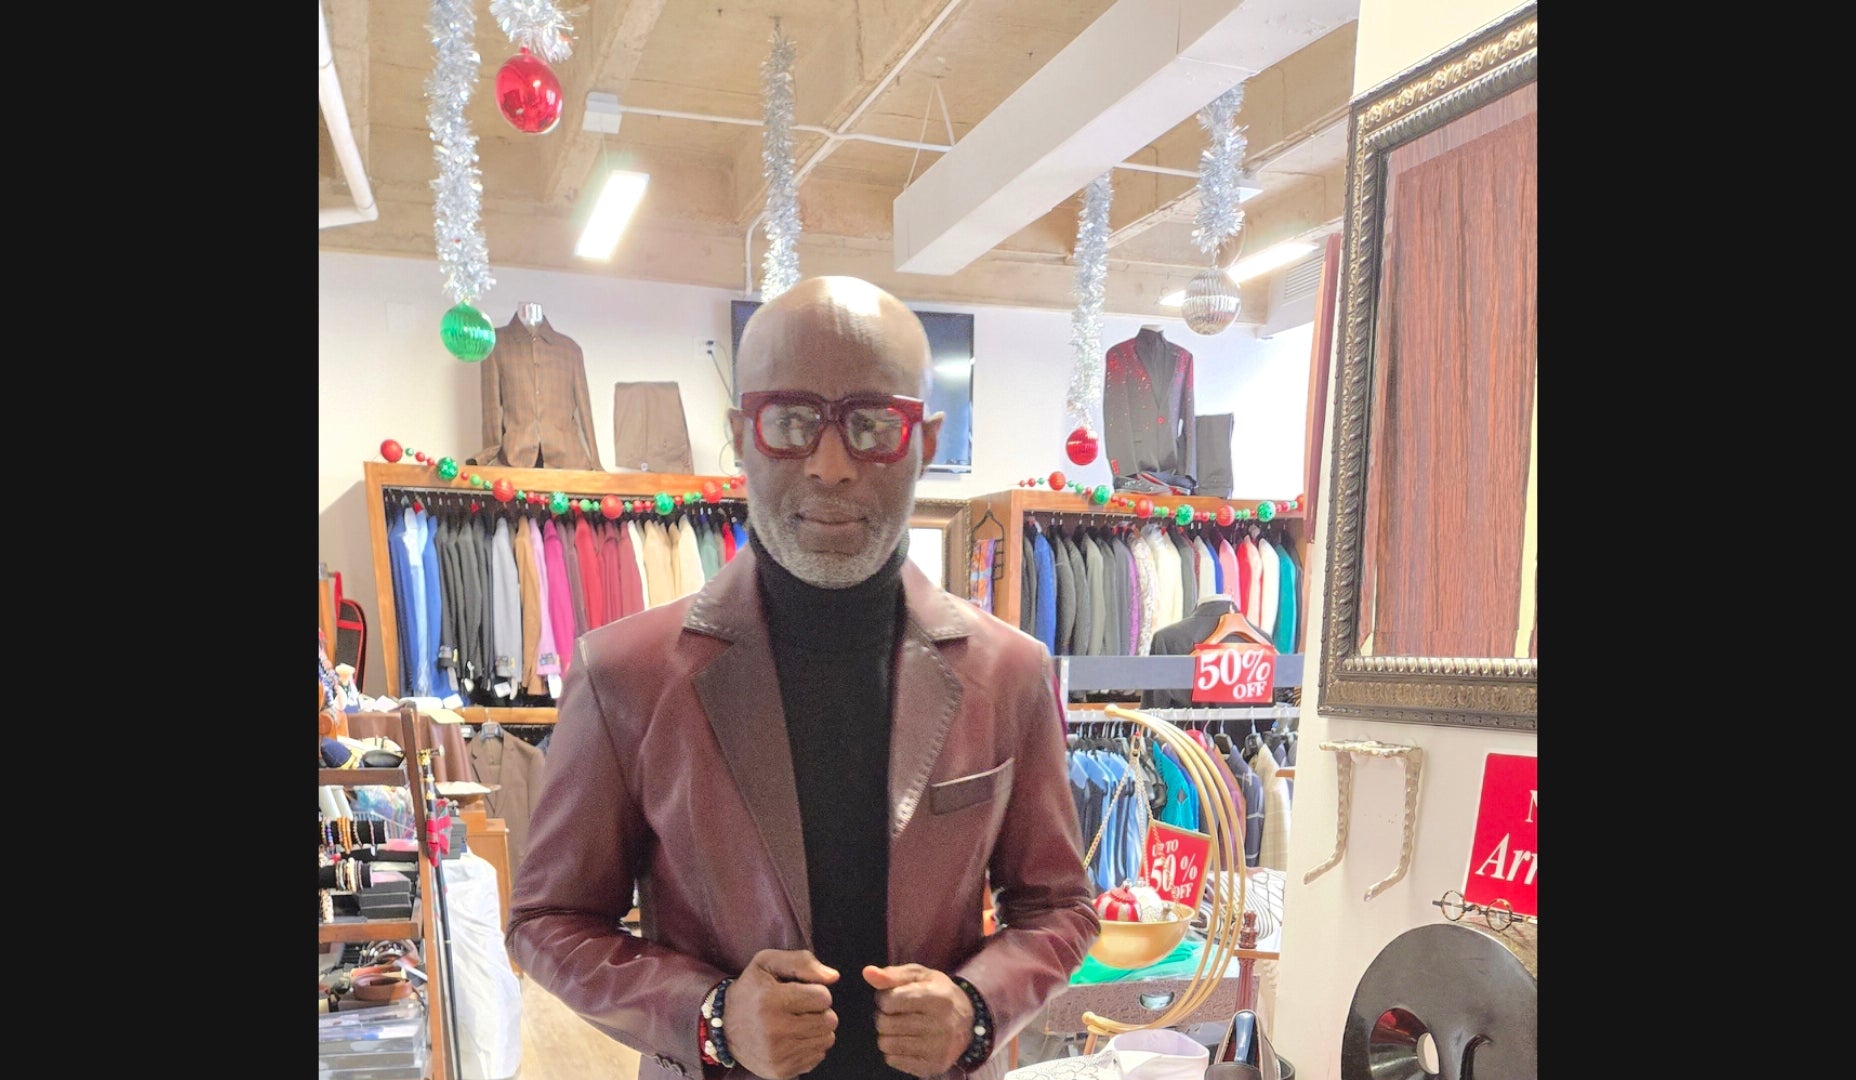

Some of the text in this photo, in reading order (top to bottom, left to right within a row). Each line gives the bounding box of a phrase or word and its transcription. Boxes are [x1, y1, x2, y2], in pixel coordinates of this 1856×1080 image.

[1198, 649, 1271, 690] 50%
[1231, 681, 1267, 700] OFF
[1166, 839, 1179, 854] TO
